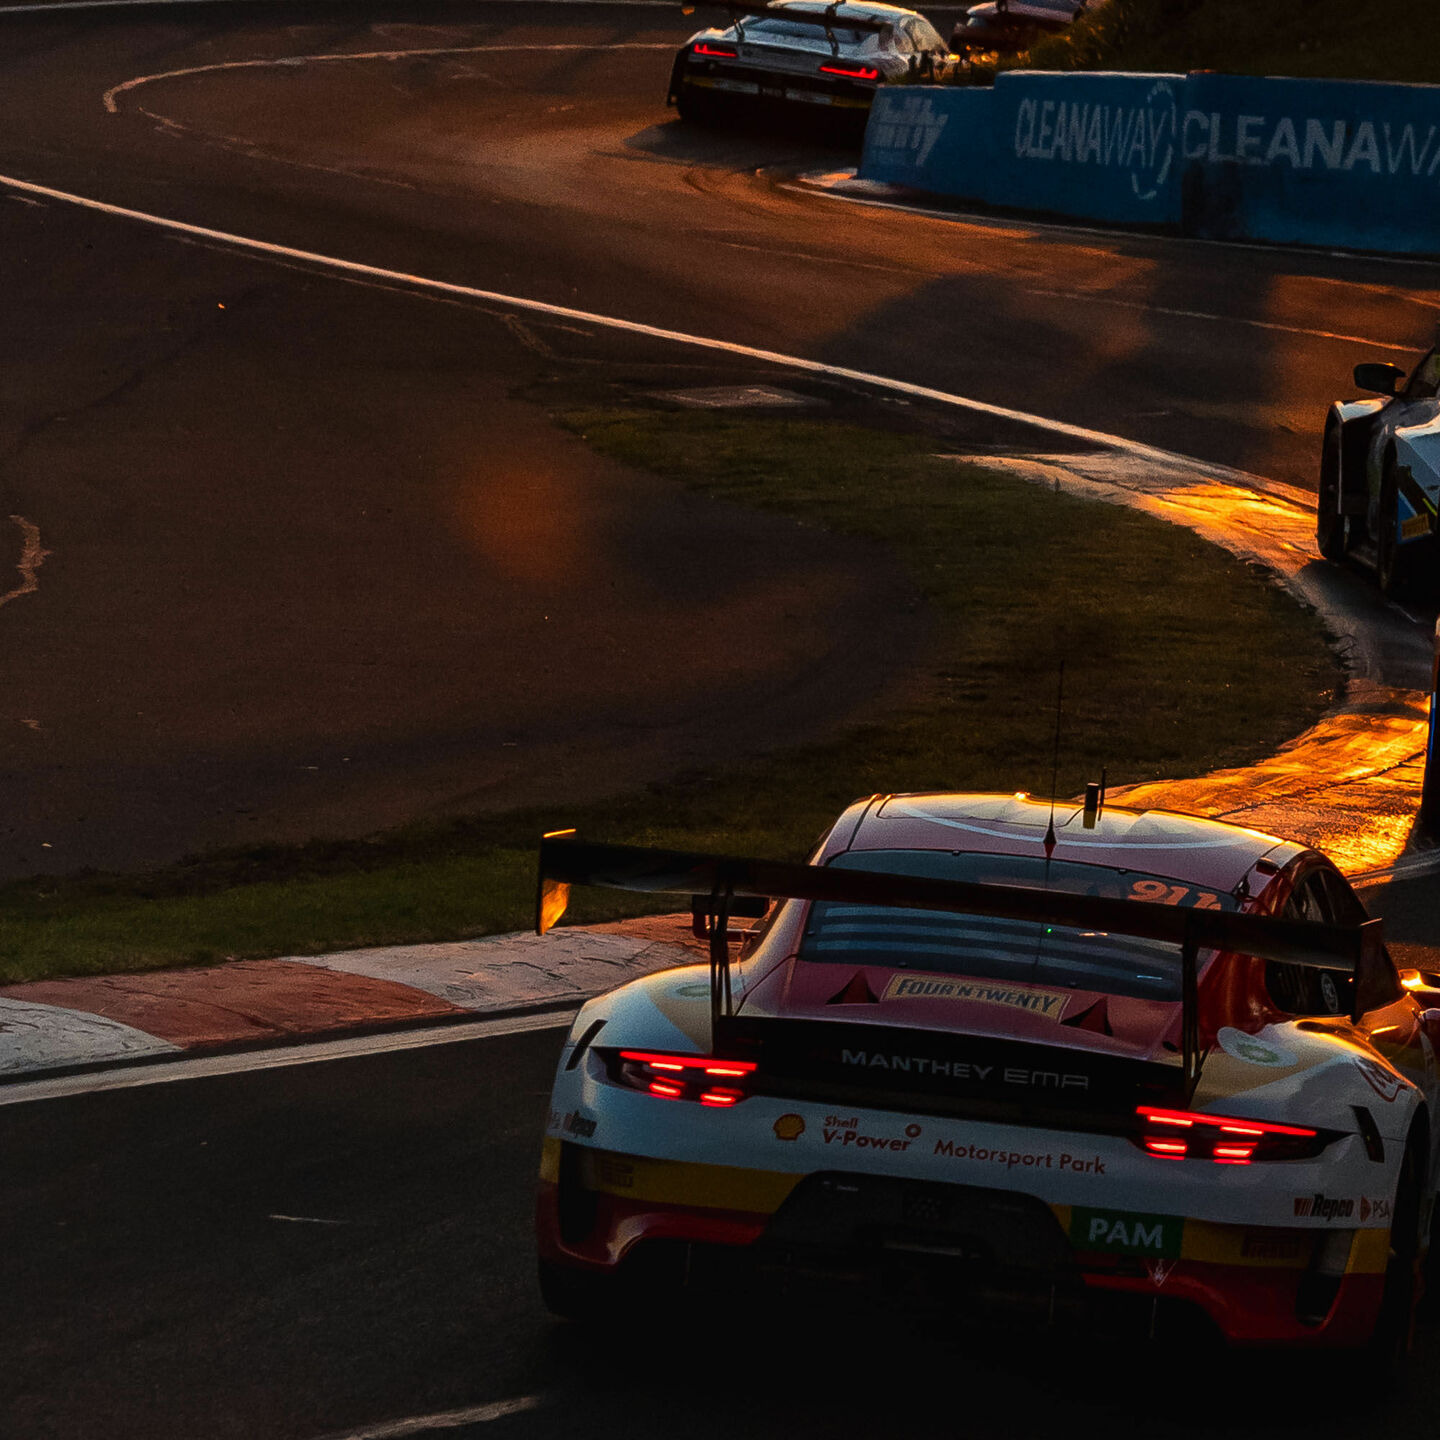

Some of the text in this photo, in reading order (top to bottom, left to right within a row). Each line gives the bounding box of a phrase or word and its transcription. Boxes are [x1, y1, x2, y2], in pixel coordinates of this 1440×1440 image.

[1015, 97, 1168, 169] CLEANAWAY
[974, 988, 1057, 1013] TWENTY
[841, 1048, 993, 1081] MANTHEY
[824, 1115, 858, 1129] Shell
[823, 1128, 911, 1151] V-Power
[934, 1139, 1106, 1175] Motorsport Park
[1312, 1193, 1354, 1221] Repco
[1088, 1217, 1163, 1249] PAM
